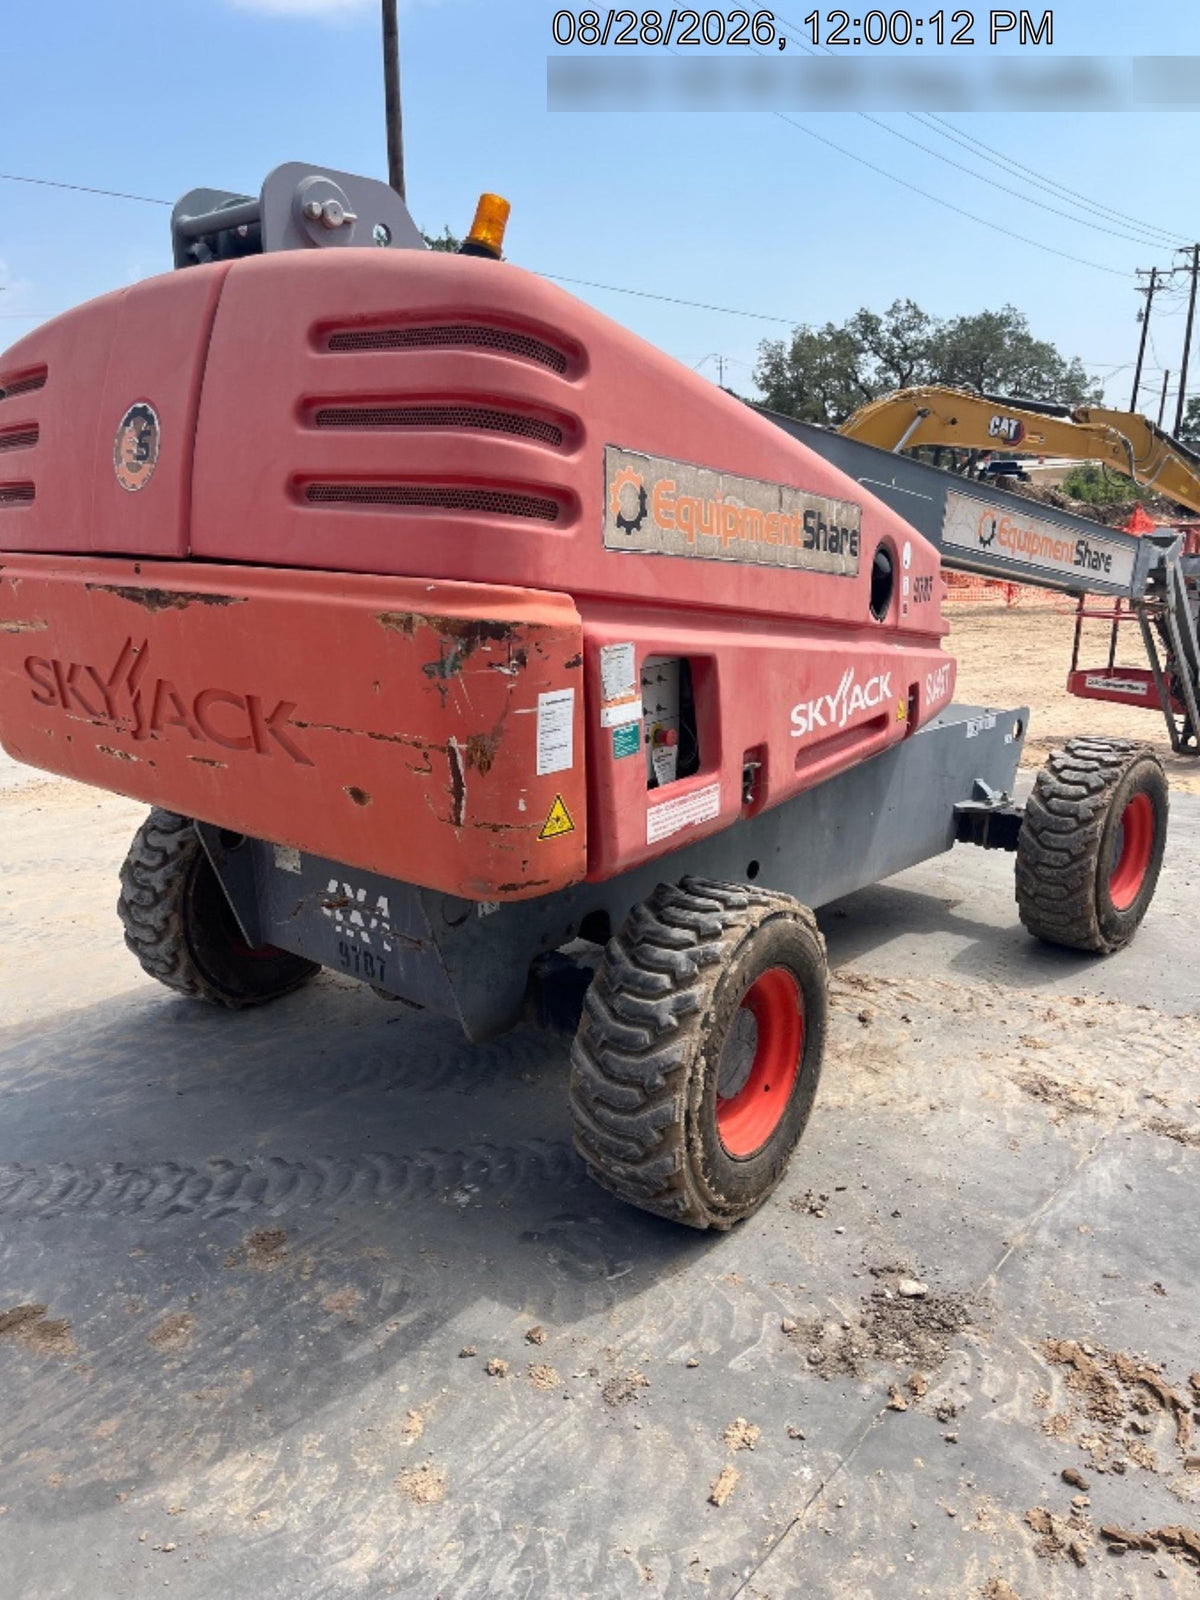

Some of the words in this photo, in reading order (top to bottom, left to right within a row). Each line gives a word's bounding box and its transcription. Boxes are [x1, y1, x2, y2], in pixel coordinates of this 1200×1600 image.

[988, 415, 1019, 440] CAT
[653, 479, 859, 557] EquipmentShare
[997, 515, 1112, 574] EquipmentShare
[24, 635, 315, 767] SKYJACK
[790, 666, 892, 737] SKYJACK
